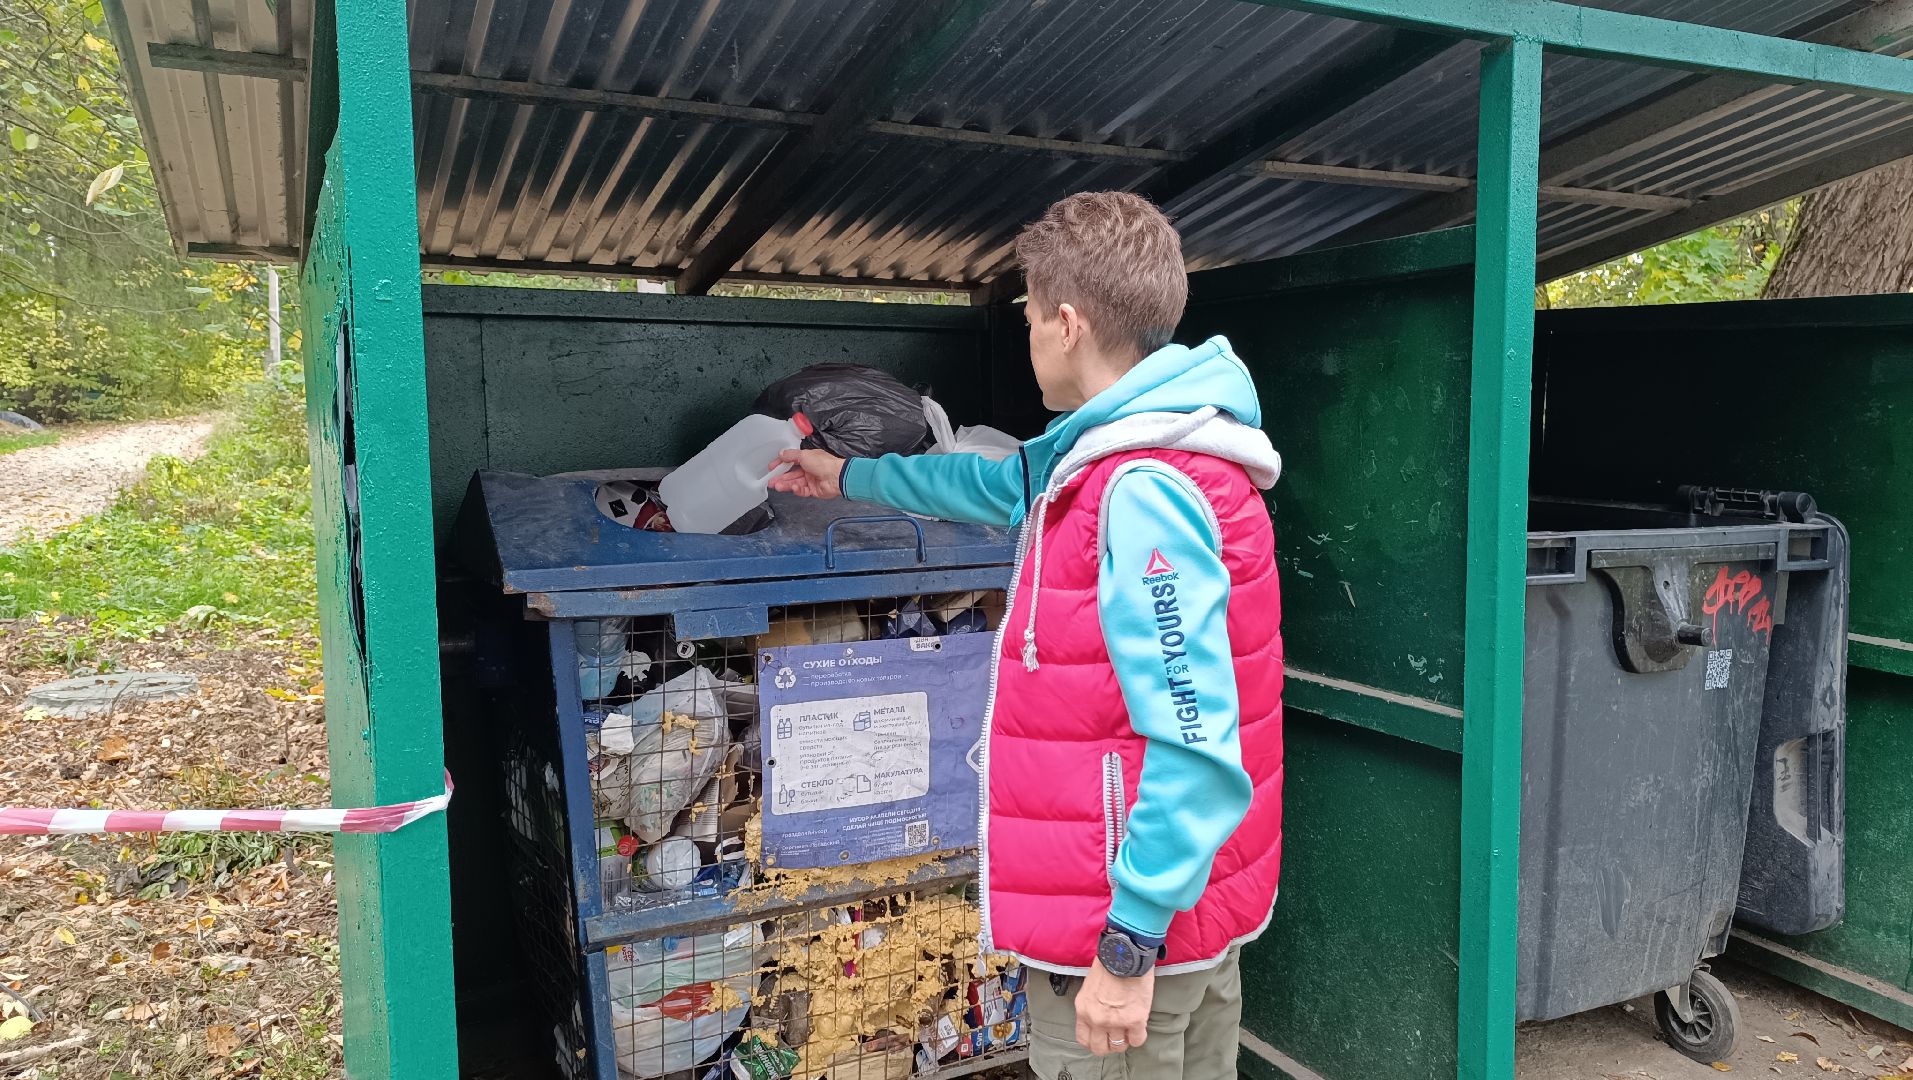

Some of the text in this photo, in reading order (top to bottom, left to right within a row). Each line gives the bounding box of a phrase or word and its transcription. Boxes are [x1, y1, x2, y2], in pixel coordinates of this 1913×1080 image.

[1142, 571, 1180, 586] Reebok
[803, 656, 882, 669] СУХИЕ ОТХОДЫ
[1151, 582, 1208, 745] FIGHT FOR YOURS
[873, 705, 906, 716] МЕТАЛЛ
[799, 712, 839, 722] ПЛАСТИК
[874, 767, 924, 780] МАКУЛАТУРА
[801, 779, 834, 788] СТЕКЛО
[849, 815, 870, 823] МУСОР
[842, 823, 867, 832] СДЕЛАЙ
